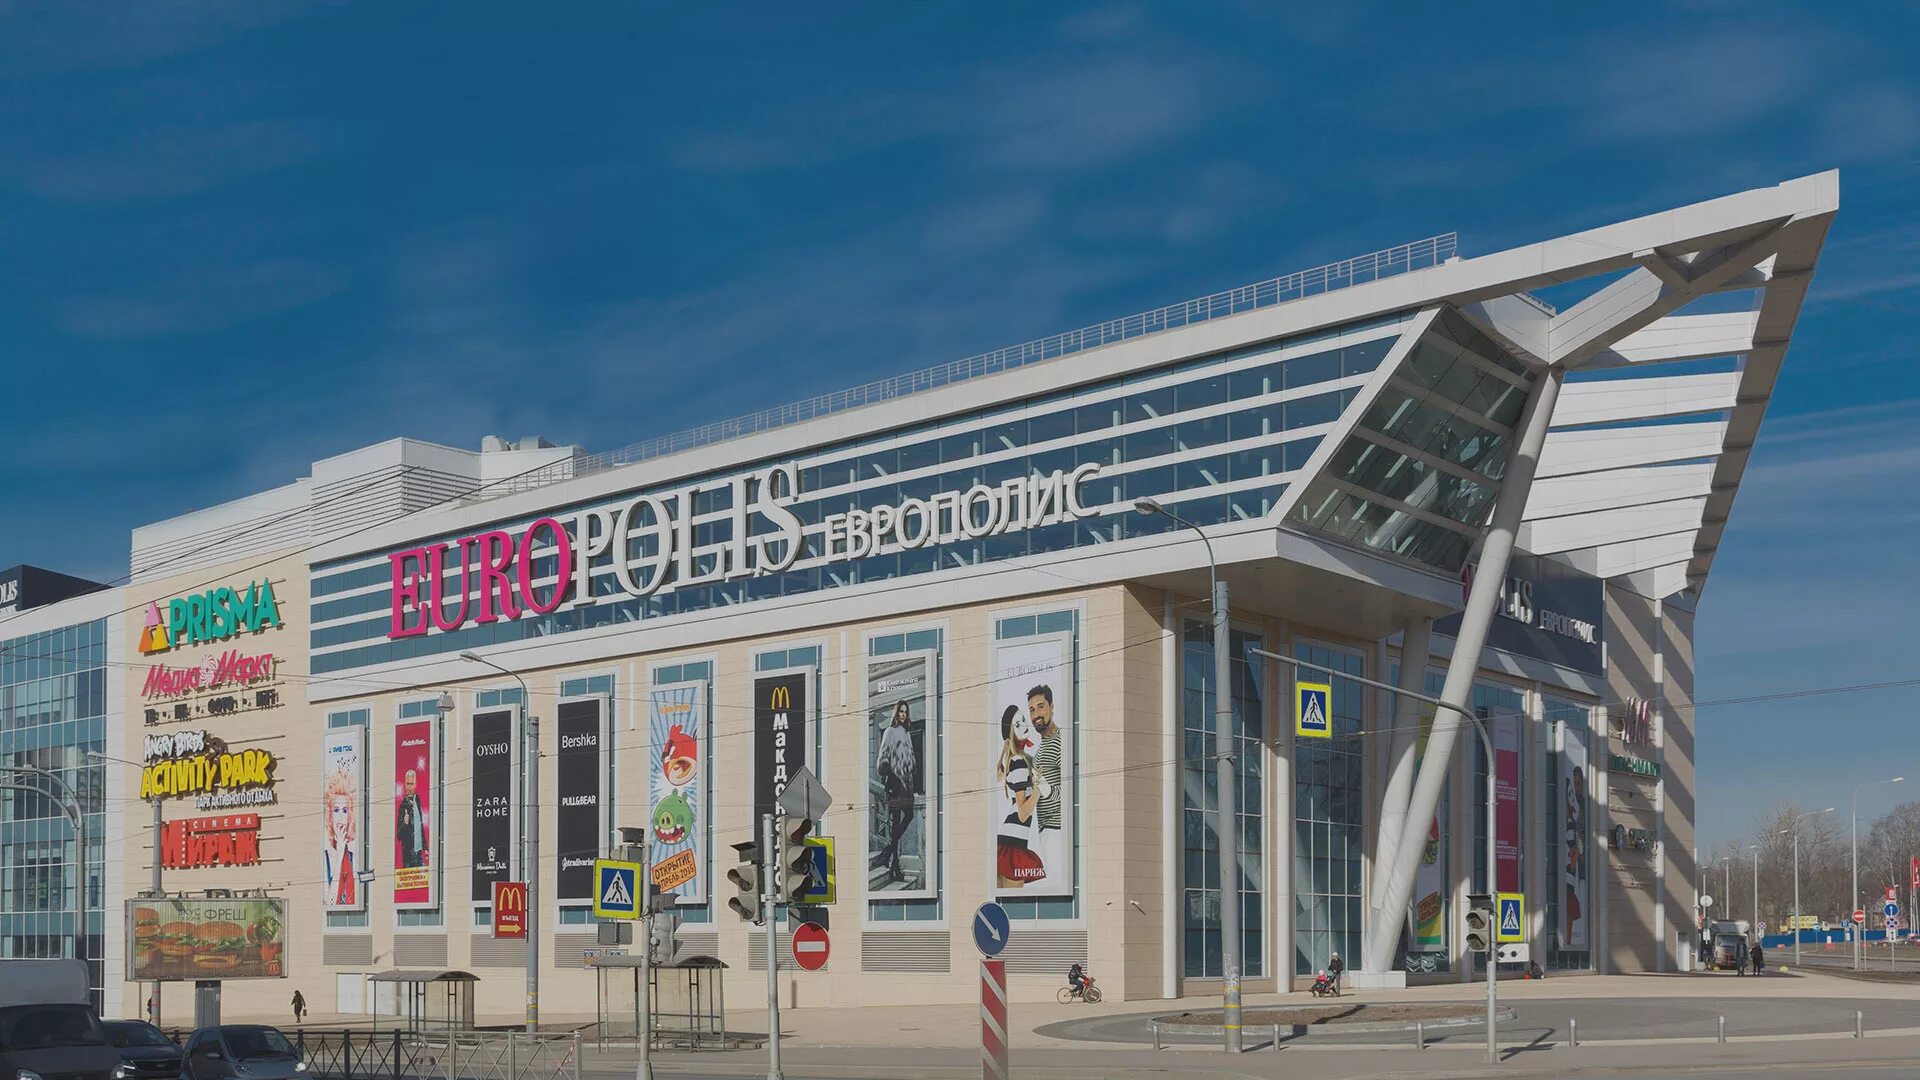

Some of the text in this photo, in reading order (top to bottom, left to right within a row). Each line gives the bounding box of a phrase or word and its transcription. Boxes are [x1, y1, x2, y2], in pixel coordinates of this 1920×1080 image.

[824, 462, 1100, 563] ЕВРОПОЛИС
[387, 461, 802, 638] EUROPOLIS
[169, 577, 279, 648] PRISMA
[562, 733, 597, 748] Bershka
[476, 742, 508, 756] OYSHO
[141, 749, 270, 799] ACTIVITY PARK
[476, 796, 508, 807] ZARA
[476, 807, 508, 818] HOME
[193, 817, 252, 829] CINEMA
[654, 853, 691, 880] ОТКРЫТИЕ
[1014, 867, 1045, 878] ПАРИЖ
[204, 908, 246, 921] ФРЕШ
